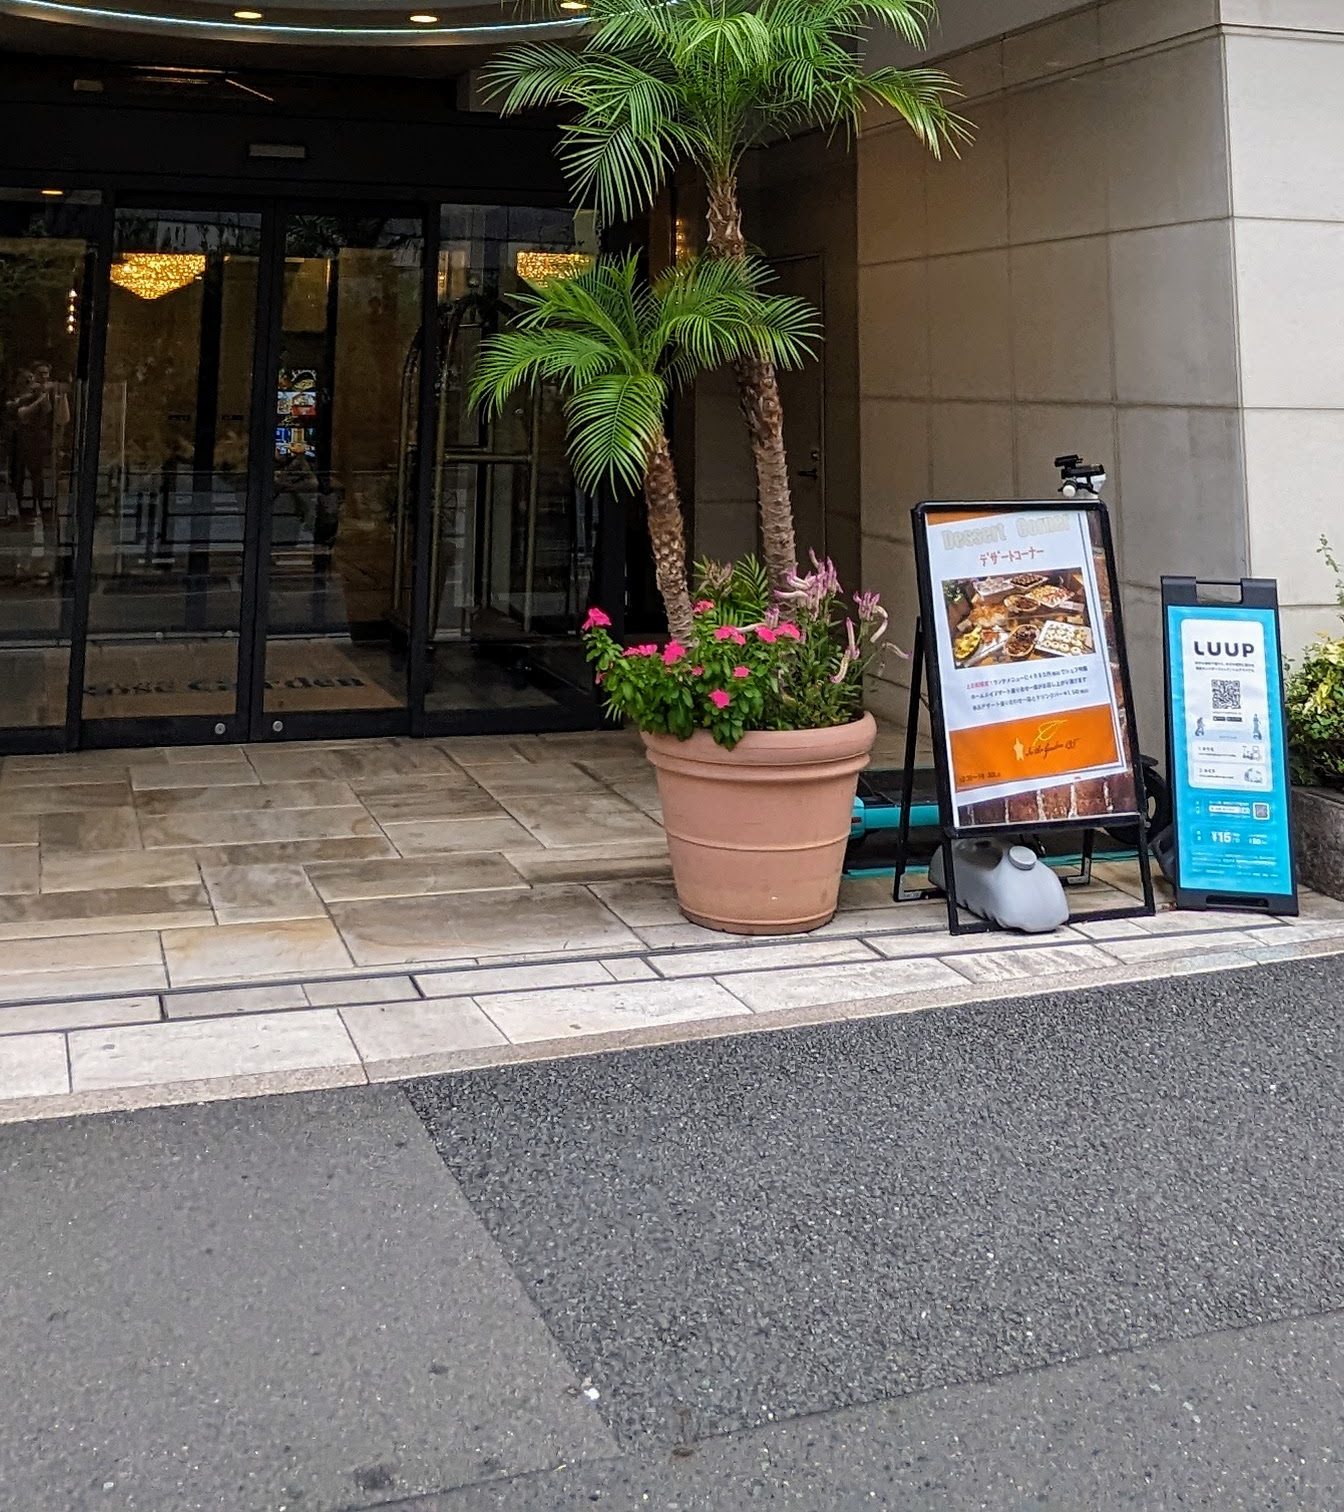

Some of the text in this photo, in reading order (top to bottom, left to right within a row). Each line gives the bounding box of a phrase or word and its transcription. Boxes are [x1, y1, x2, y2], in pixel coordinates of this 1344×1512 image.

[941, 523, 1007, 550] Dessert
[979, 546, 1044, 567] デザートコーナー
[1193, 641, 1255, 657] LUUP
